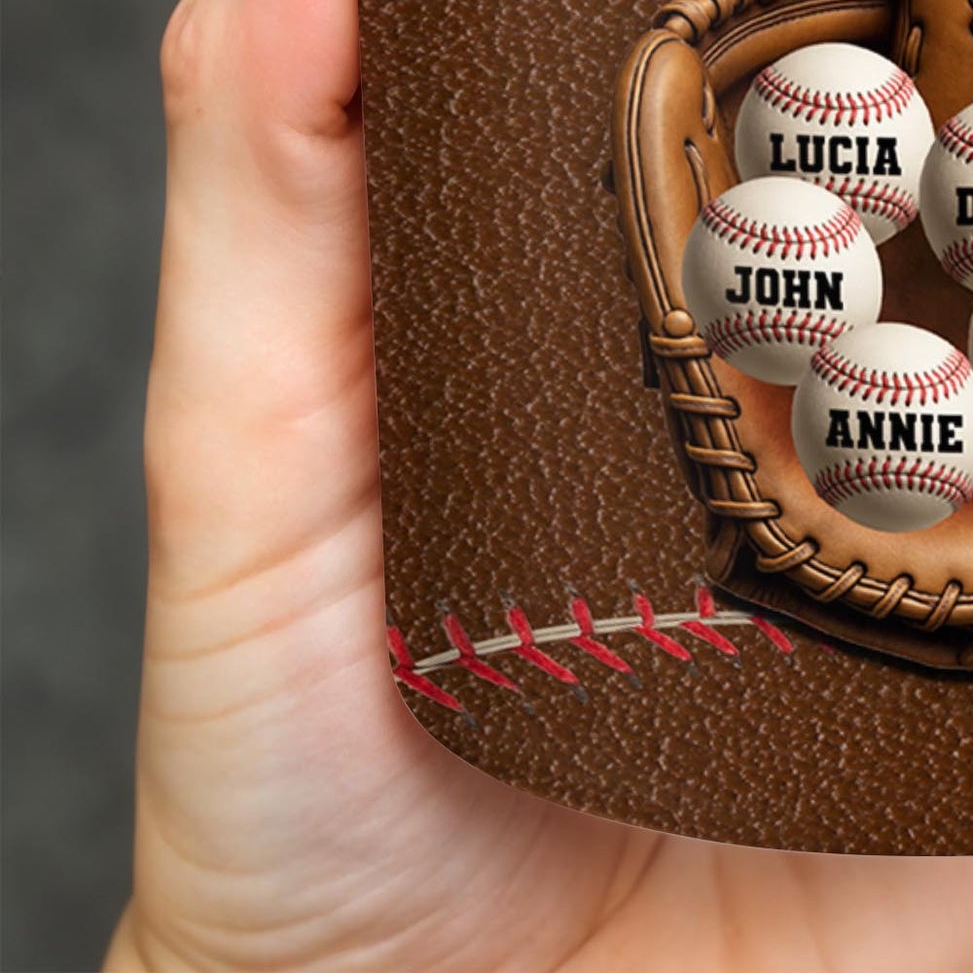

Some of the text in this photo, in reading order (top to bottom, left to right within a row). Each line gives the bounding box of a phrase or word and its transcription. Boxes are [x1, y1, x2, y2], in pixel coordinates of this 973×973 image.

[769, 132, 902, 176] LUCIA
[725, 265, 844, 311] JOHN
[825, 408, 963, 453] ANNIE
